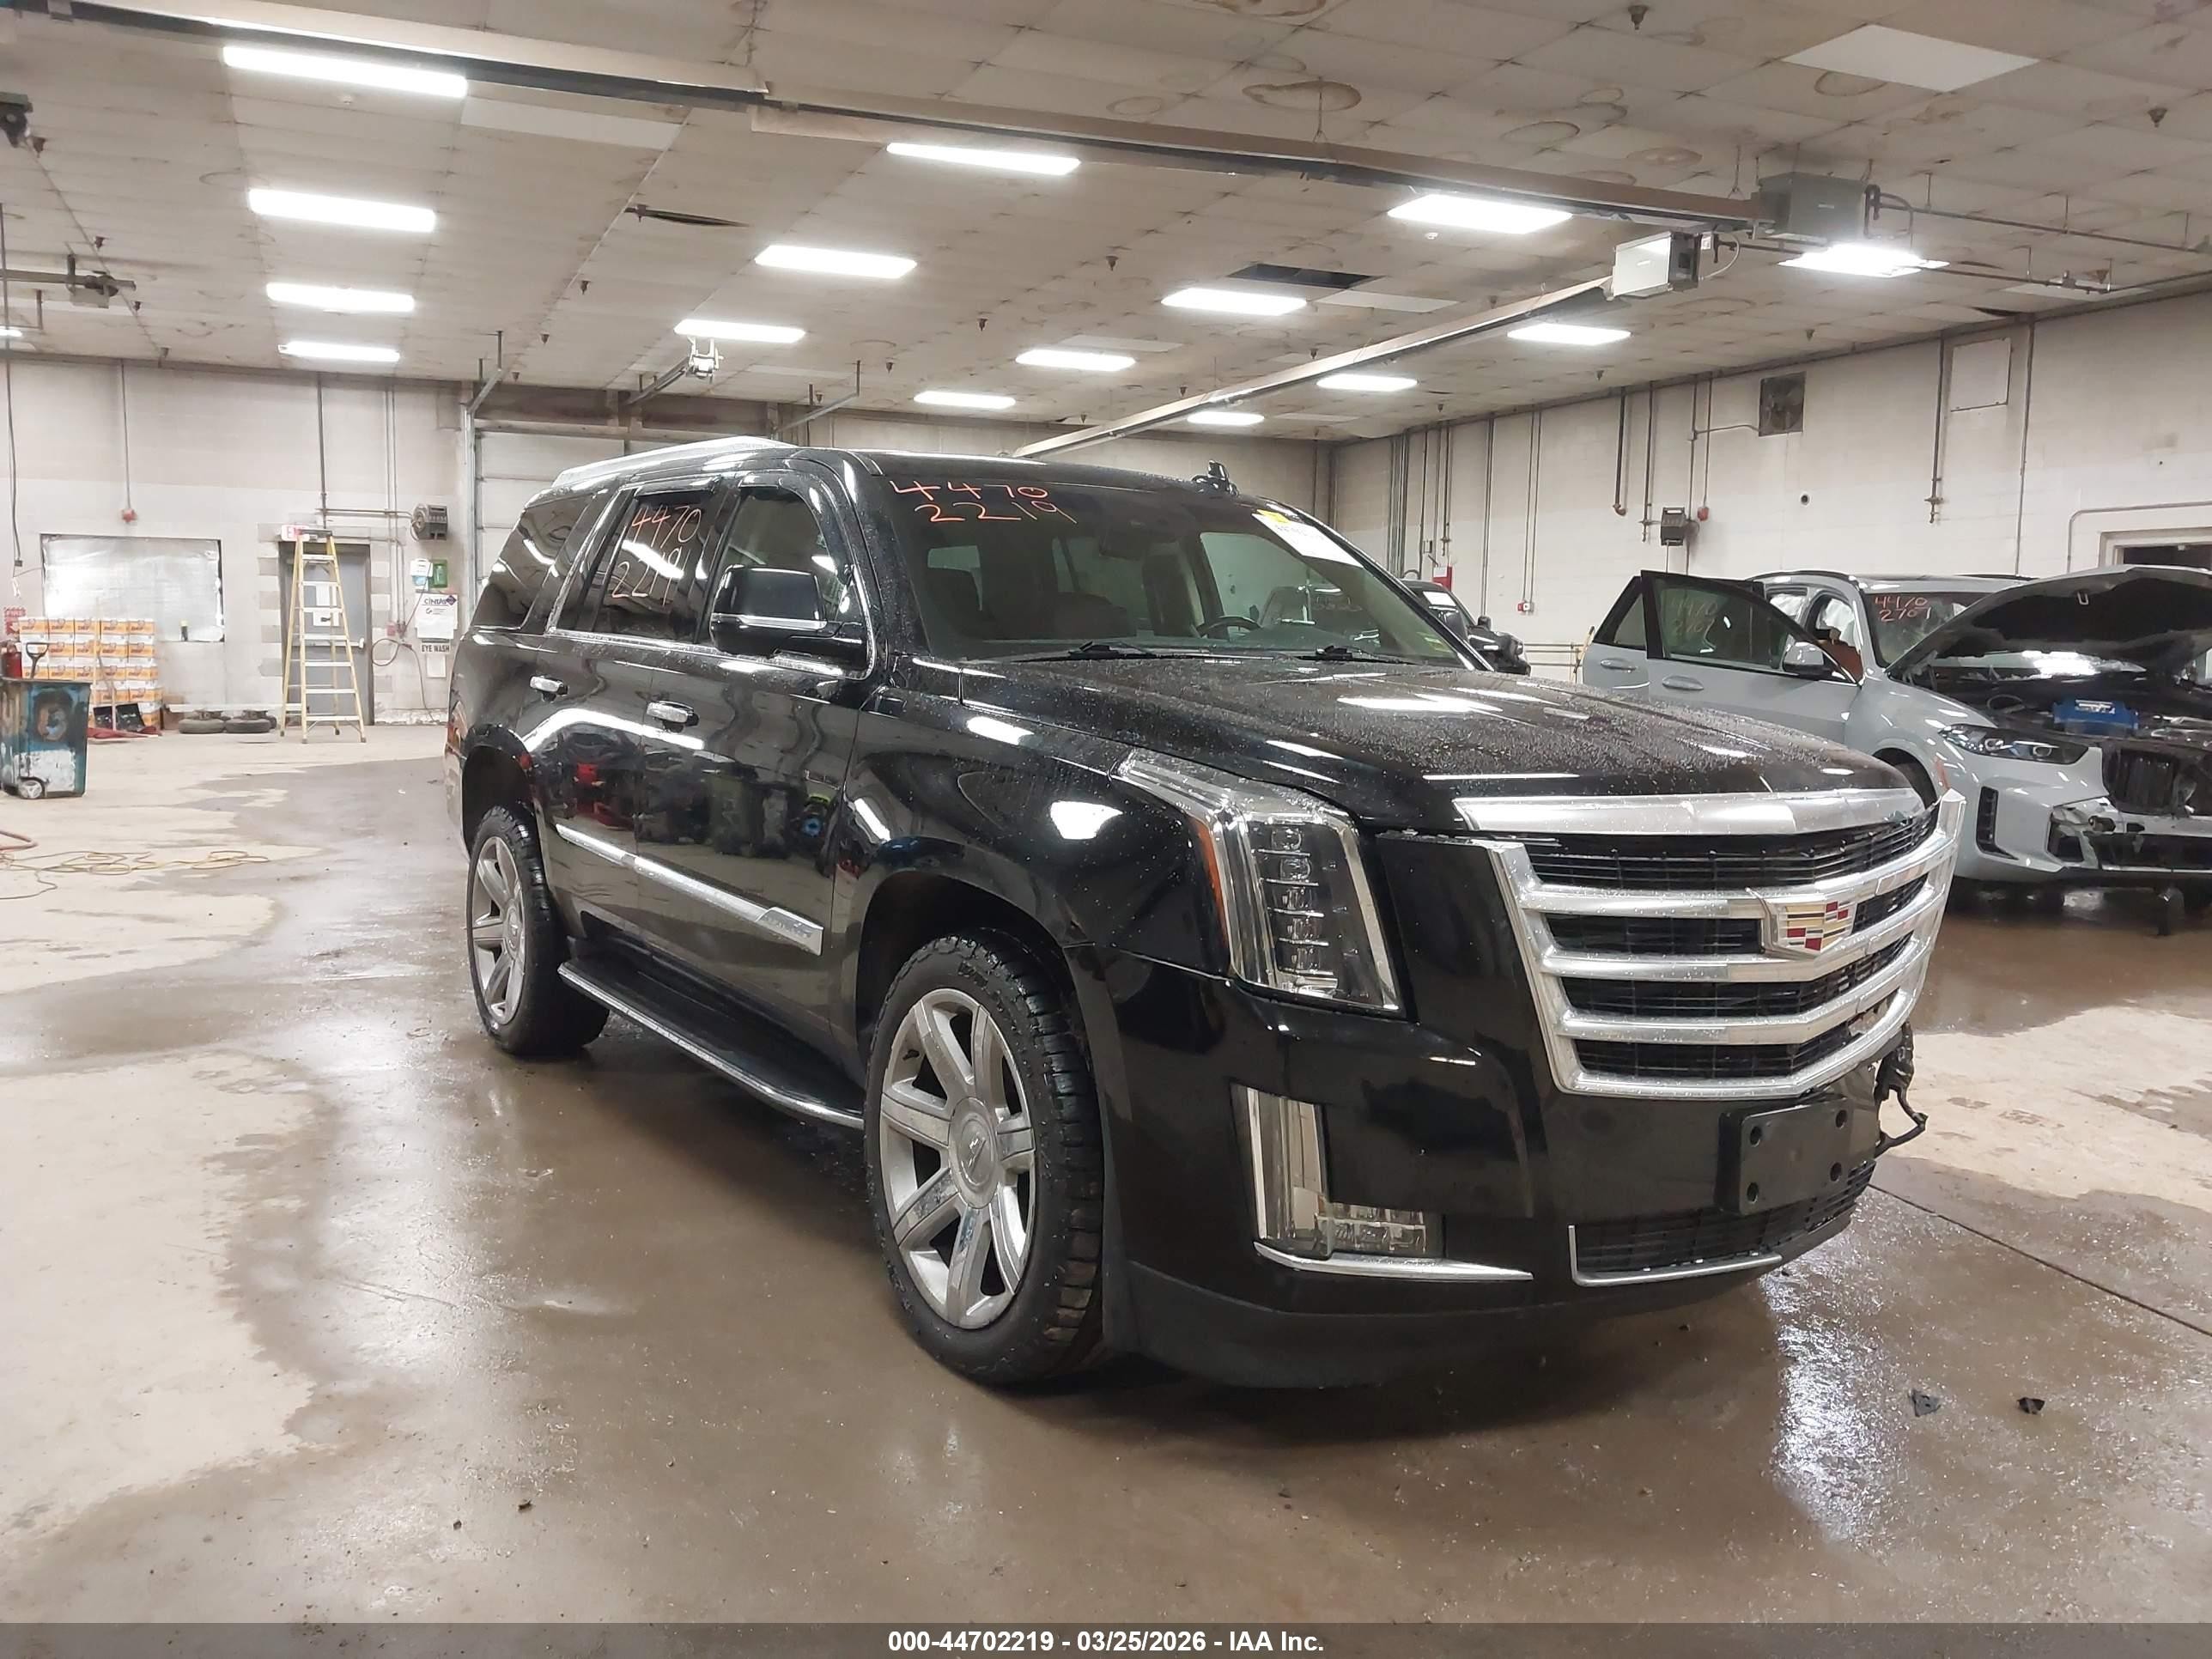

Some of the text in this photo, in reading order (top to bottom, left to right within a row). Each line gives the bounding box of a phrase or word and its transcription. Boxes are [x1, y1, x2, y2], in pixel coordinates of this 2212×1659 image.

[889, 480, 1048, 501] 4470
[914, 501, 1078, 524] 2219
[632, 504, 702, 548] 4470
